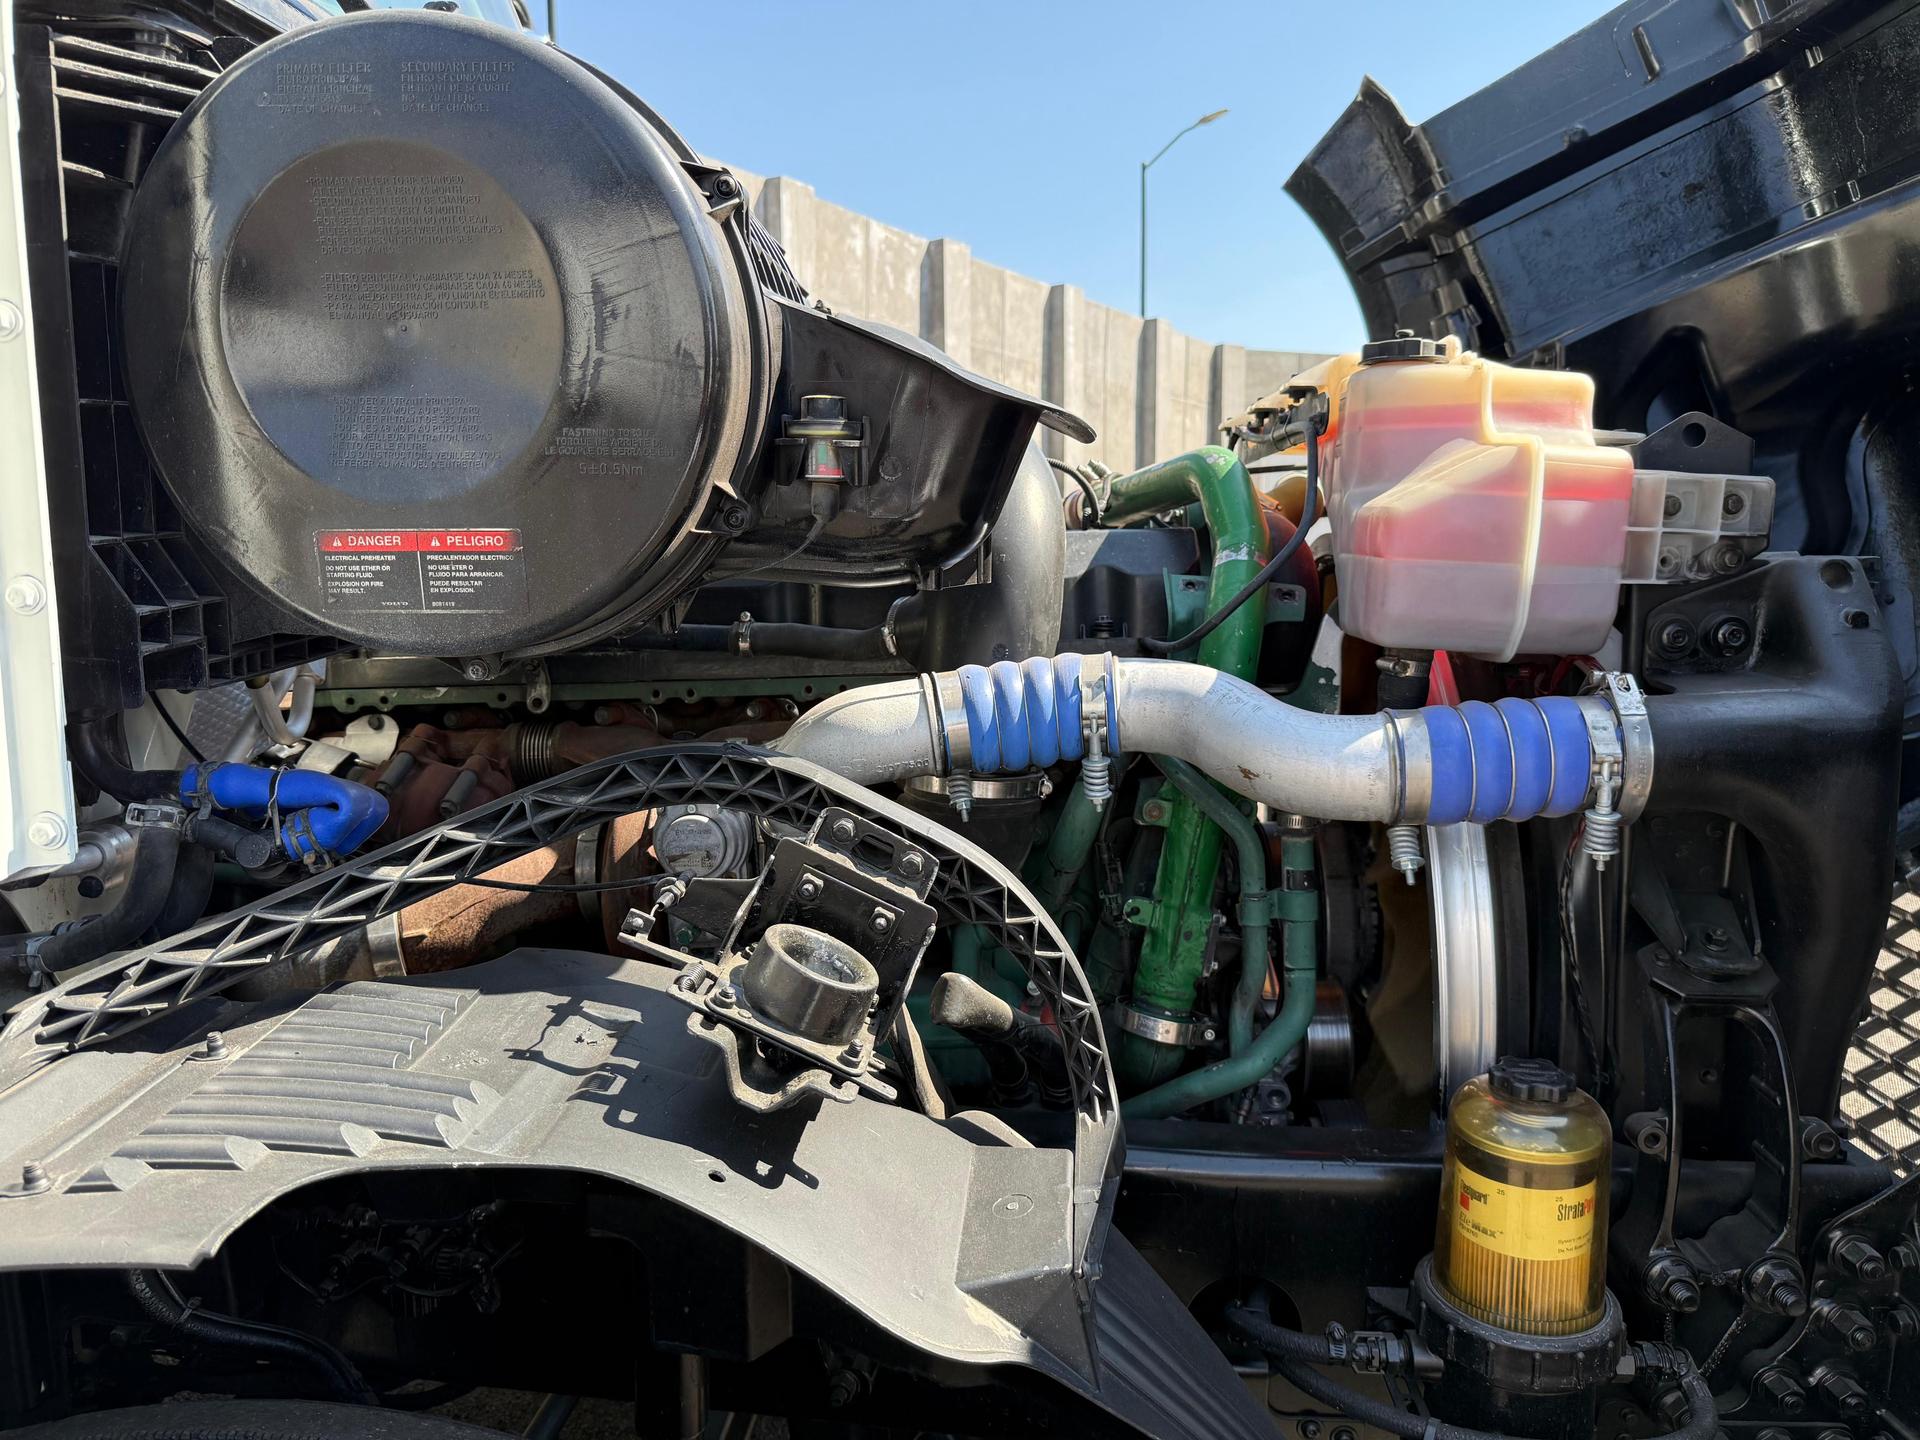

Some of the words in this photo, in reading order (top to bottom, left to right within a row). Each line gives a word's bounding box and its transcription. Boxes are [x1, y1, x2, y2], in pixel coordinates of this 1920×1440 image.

[276, 63, 325, 74] PRIMARY
[328, 62, 371, 72] FILTER
[401, 62, 468, 72] SECONDARY
[472, 62, 514, 72] FILTER
[403, 103, 428, 112] DATE
[430, 103, 445, 112] OF
[348, 536, 401, 546] DANGER
[446, 536, 504, 546] PELIGRO
